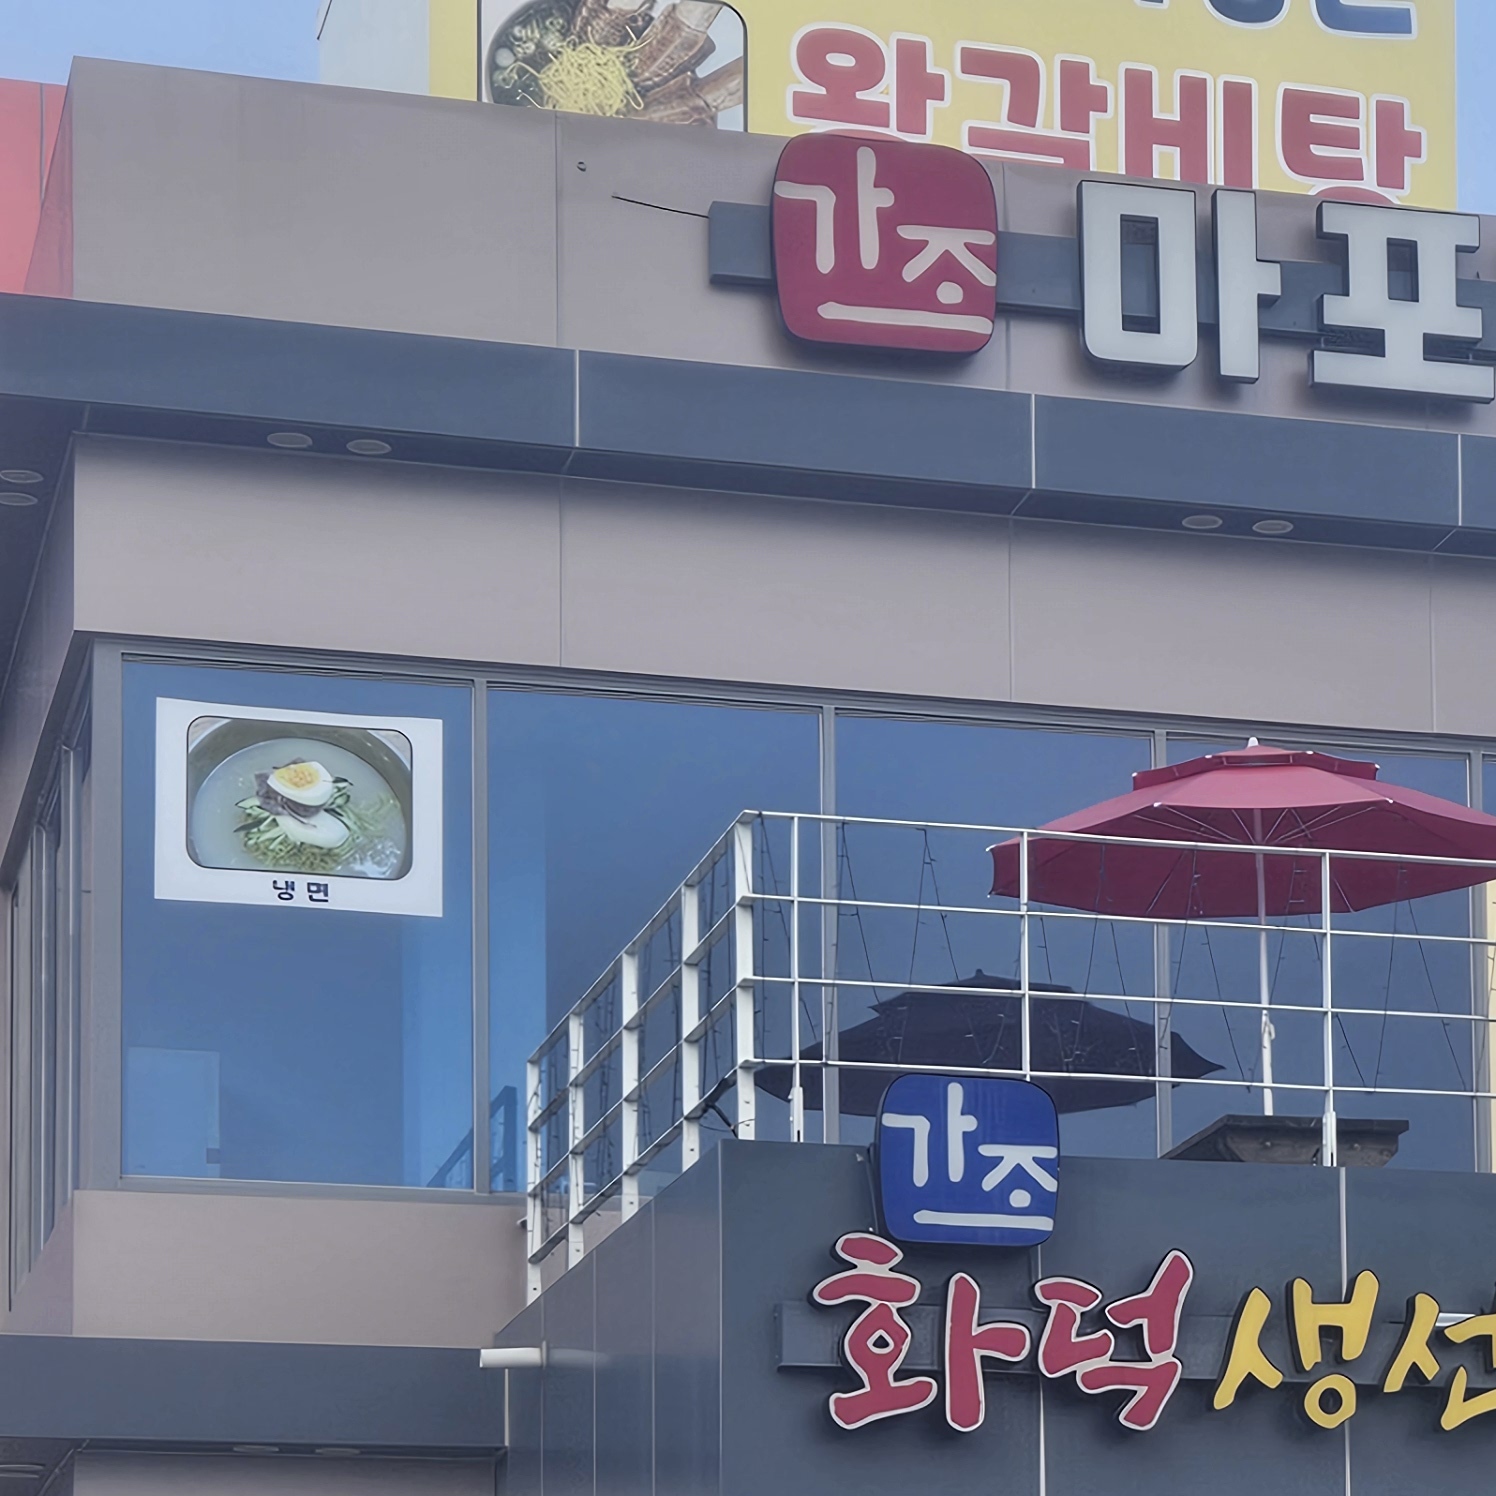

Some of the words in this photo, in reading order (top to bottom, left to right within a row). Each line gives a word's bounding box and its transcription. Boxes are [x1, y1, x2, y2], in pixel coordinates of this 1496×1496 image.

[776, 145, 996, 335] 가조
[881, 1082, 1058, 1231] 가조
[812, 1231, 1194, 1433] 화덕
